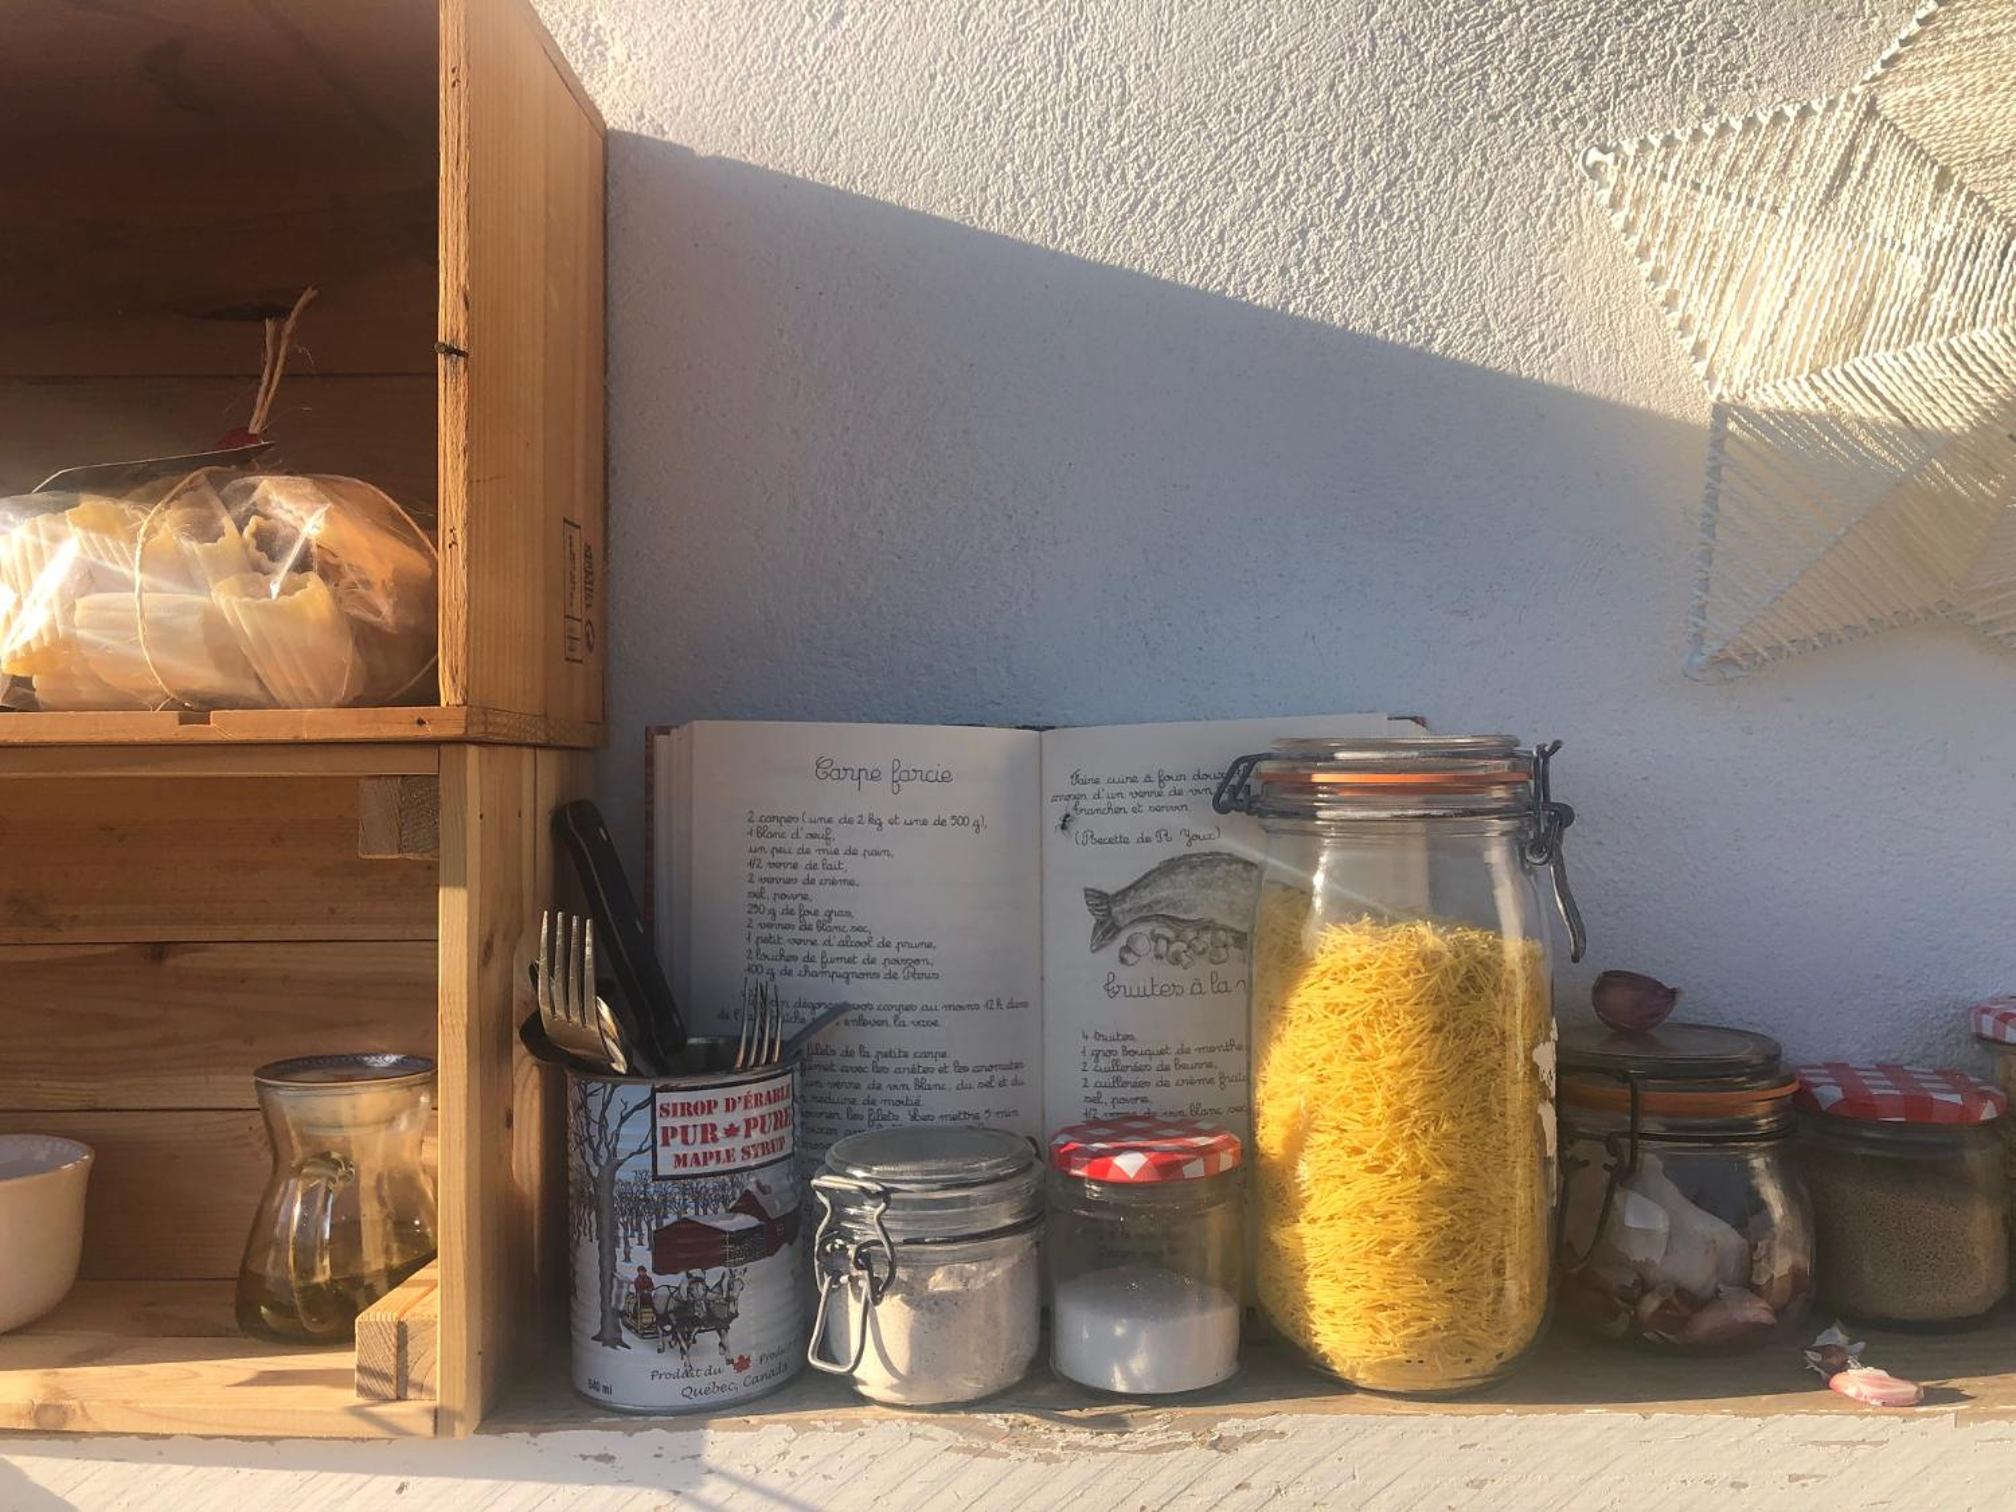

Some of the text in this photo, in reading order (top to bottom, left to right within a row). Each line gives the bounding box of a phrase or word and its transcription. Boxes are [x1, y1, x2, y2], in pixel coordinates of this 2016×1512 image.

[815, 756, 953, 795] Carpe farcie
[1107, 774, 1139, 784] cuire
[1158, 768, 1186, 789] four
[1129, 789, 1164, 799] verre
[1168, 787, 1184, 796] de
[1132, 804, 1142, 813] et
[747, 810, 755, 823] 2
[839, 816, 855, 825] de
[857, 815, 864, 824] 2
[888, 816, 900, 826] et
[903, 818, 929, 826] une
[933, 816, 947, 826] de
[951, 816, 969, 826] 500
[756, 827, 786, 839] blanc
[1136, 833, 1152, 844] de
[748, 846, 767, 855] un
[770, 847, 792, 858] peu
[797, 846, 811, 855] de
[815, 847, 840, 856] mie
[844, 846, 859, 856] de
[767, 861, 798, 870] verre
[805, 858, 817, 871] de
[747, 873, 755, 884] 2
[759, 875, 797, 885] verres
[802, 873, 816, 885] de
[747, 904, 765, 914] 250
[768, 906, 776, 921] g
[781, 904, 795, 916] de
[799, 903, 819, 923] foie
[746, 920, 753, 929] 2
[758, 922, 795, 931] verres
[799, 920, 813, 932] de
[816, 919, 845, 933] blanc
[756, 934, 782, 946] petit
[787, 937, 818, 946] verre
[877, 937, 891, 948] de
[745, 949, 754, 960] 2
[756, 948, 798, 962] louches
[802, 950, 816, 963] de
[820, 950, 858, 968] fumet
[862, 952, 876, 965] de
[766, 968, 775, 980] g
[780, 964, 793, 976] de
[797, 965, 880, 984] champignons
[884, 969, 898, 980] de
[1190, 978, 1205, 995] à
[1211, 970, 1233, 995] la
[1175, 1043, 1191, 1055] de
[1082, 1062, 1088, 1072] 2
[1155, 1060, 1170, 1071] de
[1082, 1078, 1088, 1088] 2
[1155, 1073, 1170, 1087] de
[660, 1100, 718, 1118] SIROP
[660, 1123, 720, 1147] PUR
[744, 1106, 792, 1139] PURE
[673, 1148, 736, 1169] MAPLE
[741, 1136, 785, 1161] SYRUP
[704, 1366, 721, 1377] du
[743, 1363, 788, 1387] Canada
